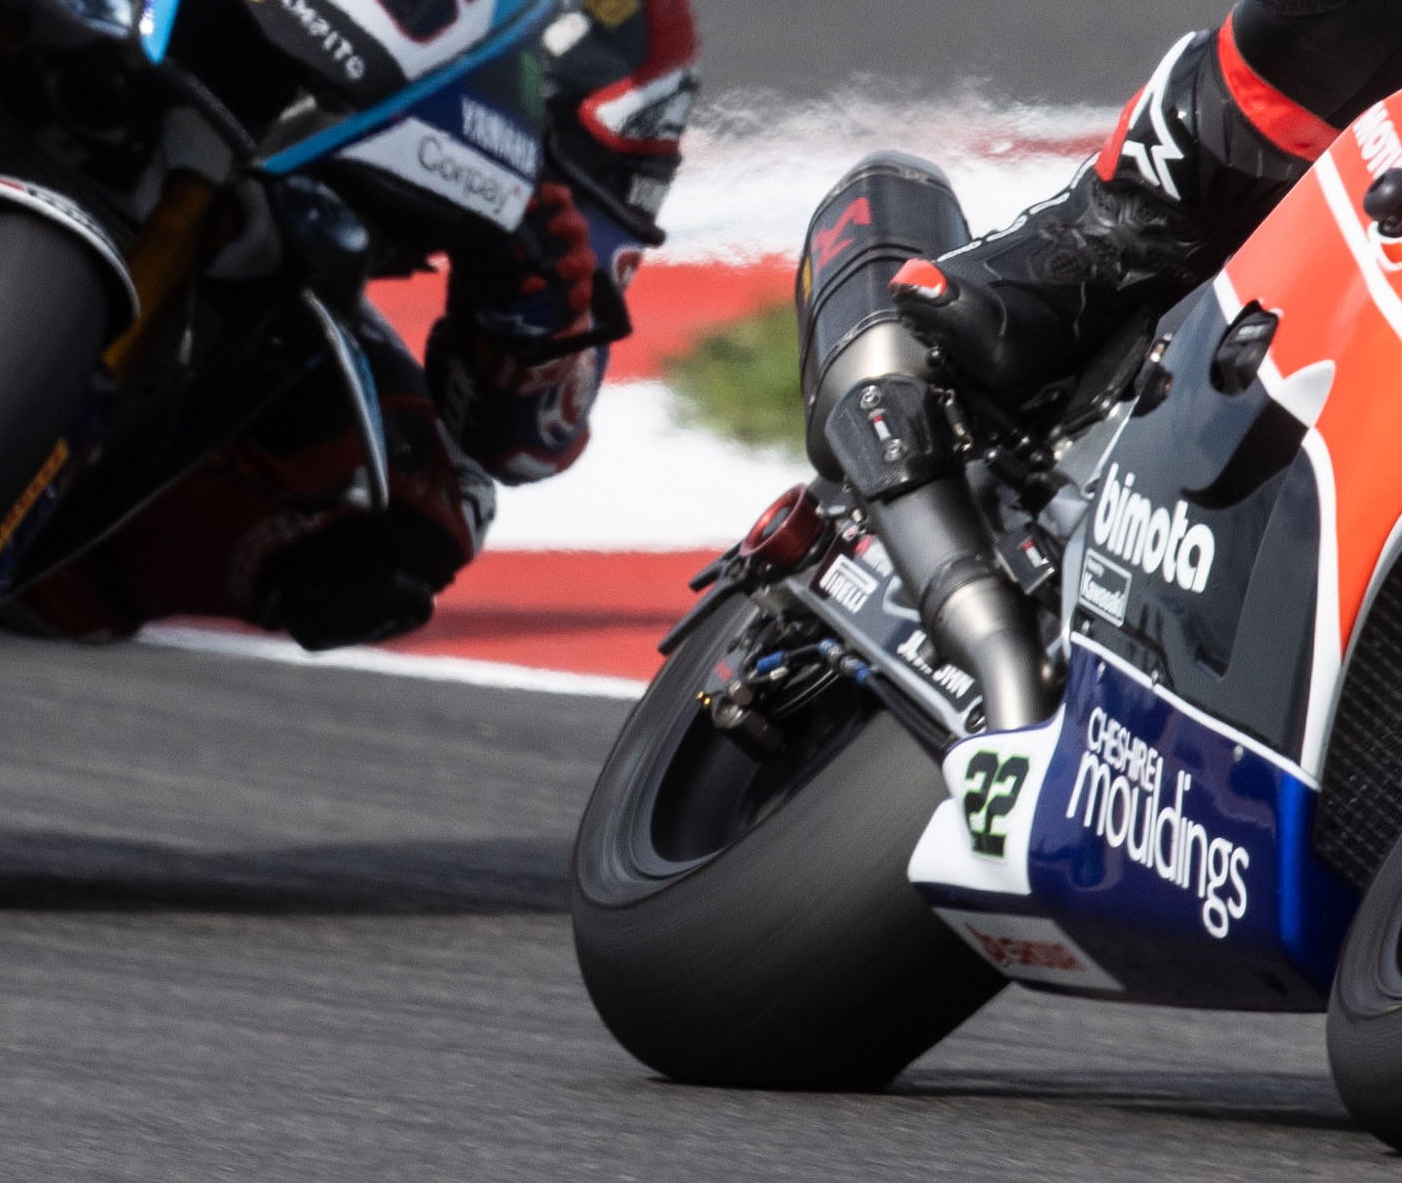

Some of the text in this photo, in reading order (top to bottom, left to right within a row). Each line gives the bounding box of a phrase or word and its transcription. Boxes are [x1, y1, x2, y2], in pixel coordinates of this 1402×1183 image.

[819, 553, 880, 615] PIRELLI
[1093, 461, 1216, 594] bimota
[963, 747, 1031, 860] 22
[1087, 707, 1157, 793] CHESHIRE
[1066, 749, 1252, 939] mouldings
